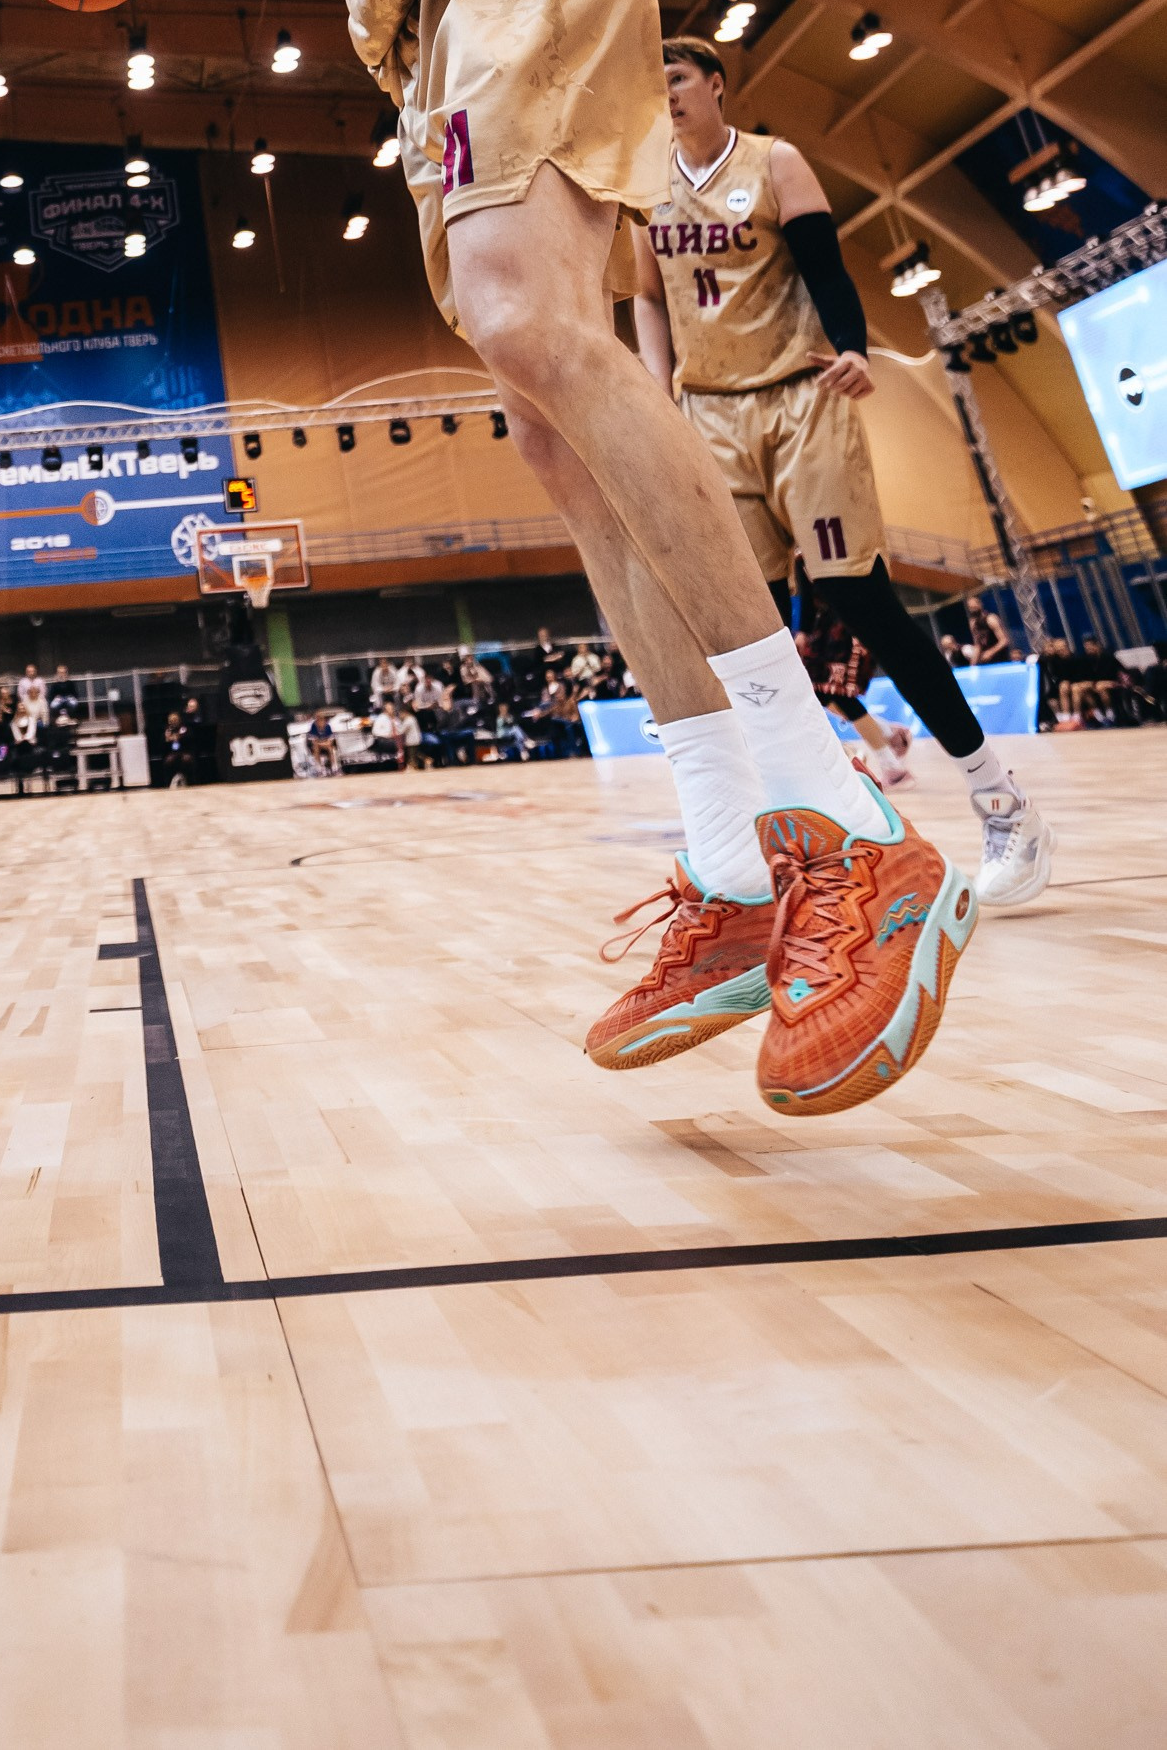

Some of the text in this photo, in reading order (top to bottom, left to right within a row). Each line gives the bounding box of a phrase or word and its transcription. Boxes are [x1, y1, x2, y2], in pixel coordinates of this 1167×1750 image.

[42, 193, 123, 220] ФИНАЛ
[648, 219, 758, 259] ЦИВС
[693, 269, 721, 308] 11
[27, 295, 157, 337] ОДНА
[83, 336, 121, 351] КЛУБА
[123, 333, 159, 348] ТВЕРЬ
[813, 516, 847, 561] 11
